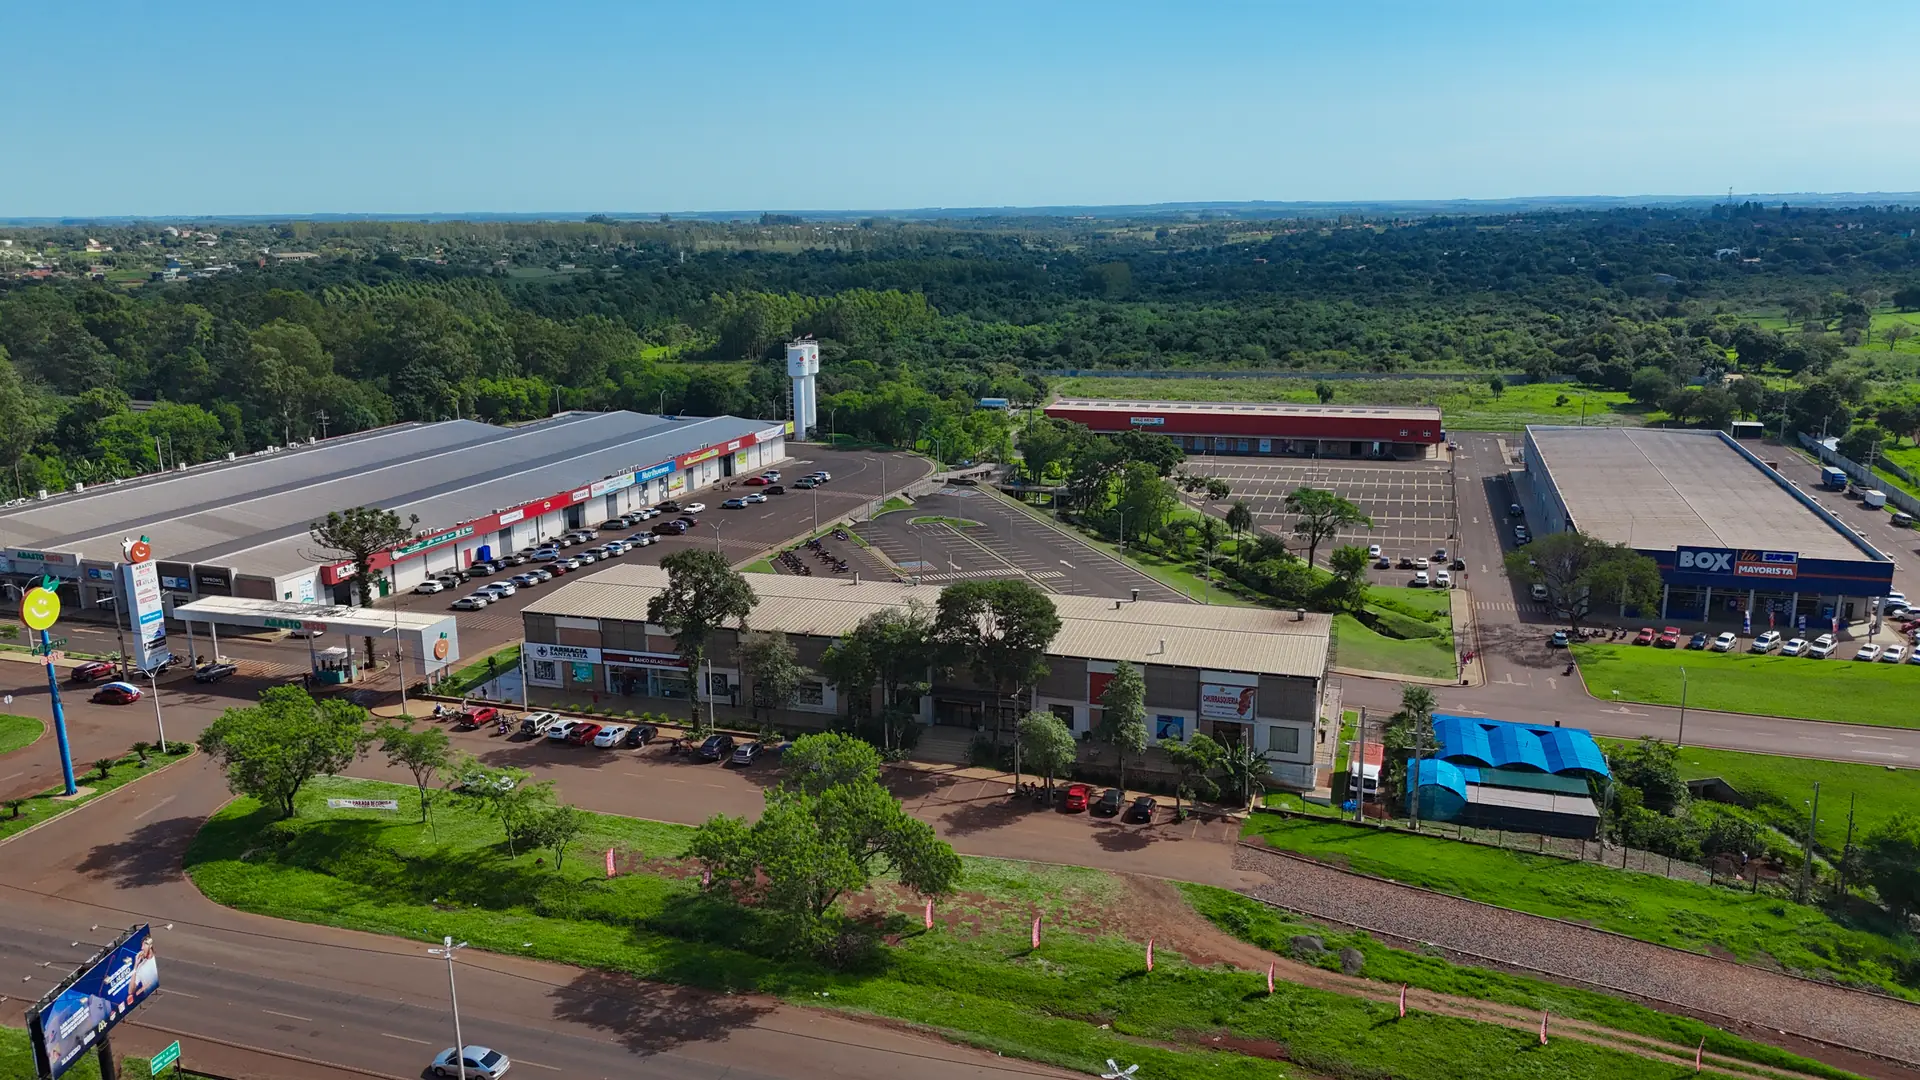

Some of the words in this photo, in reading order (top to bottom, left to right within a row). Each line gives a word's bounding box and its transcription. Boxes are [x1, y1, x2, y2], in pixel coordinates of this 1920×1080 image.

[1679, 551, 1732, 572] BOX
[1738, 565, 1794, 576] MAYORISTA
[550, 646, 588, 655] FARMACIA
